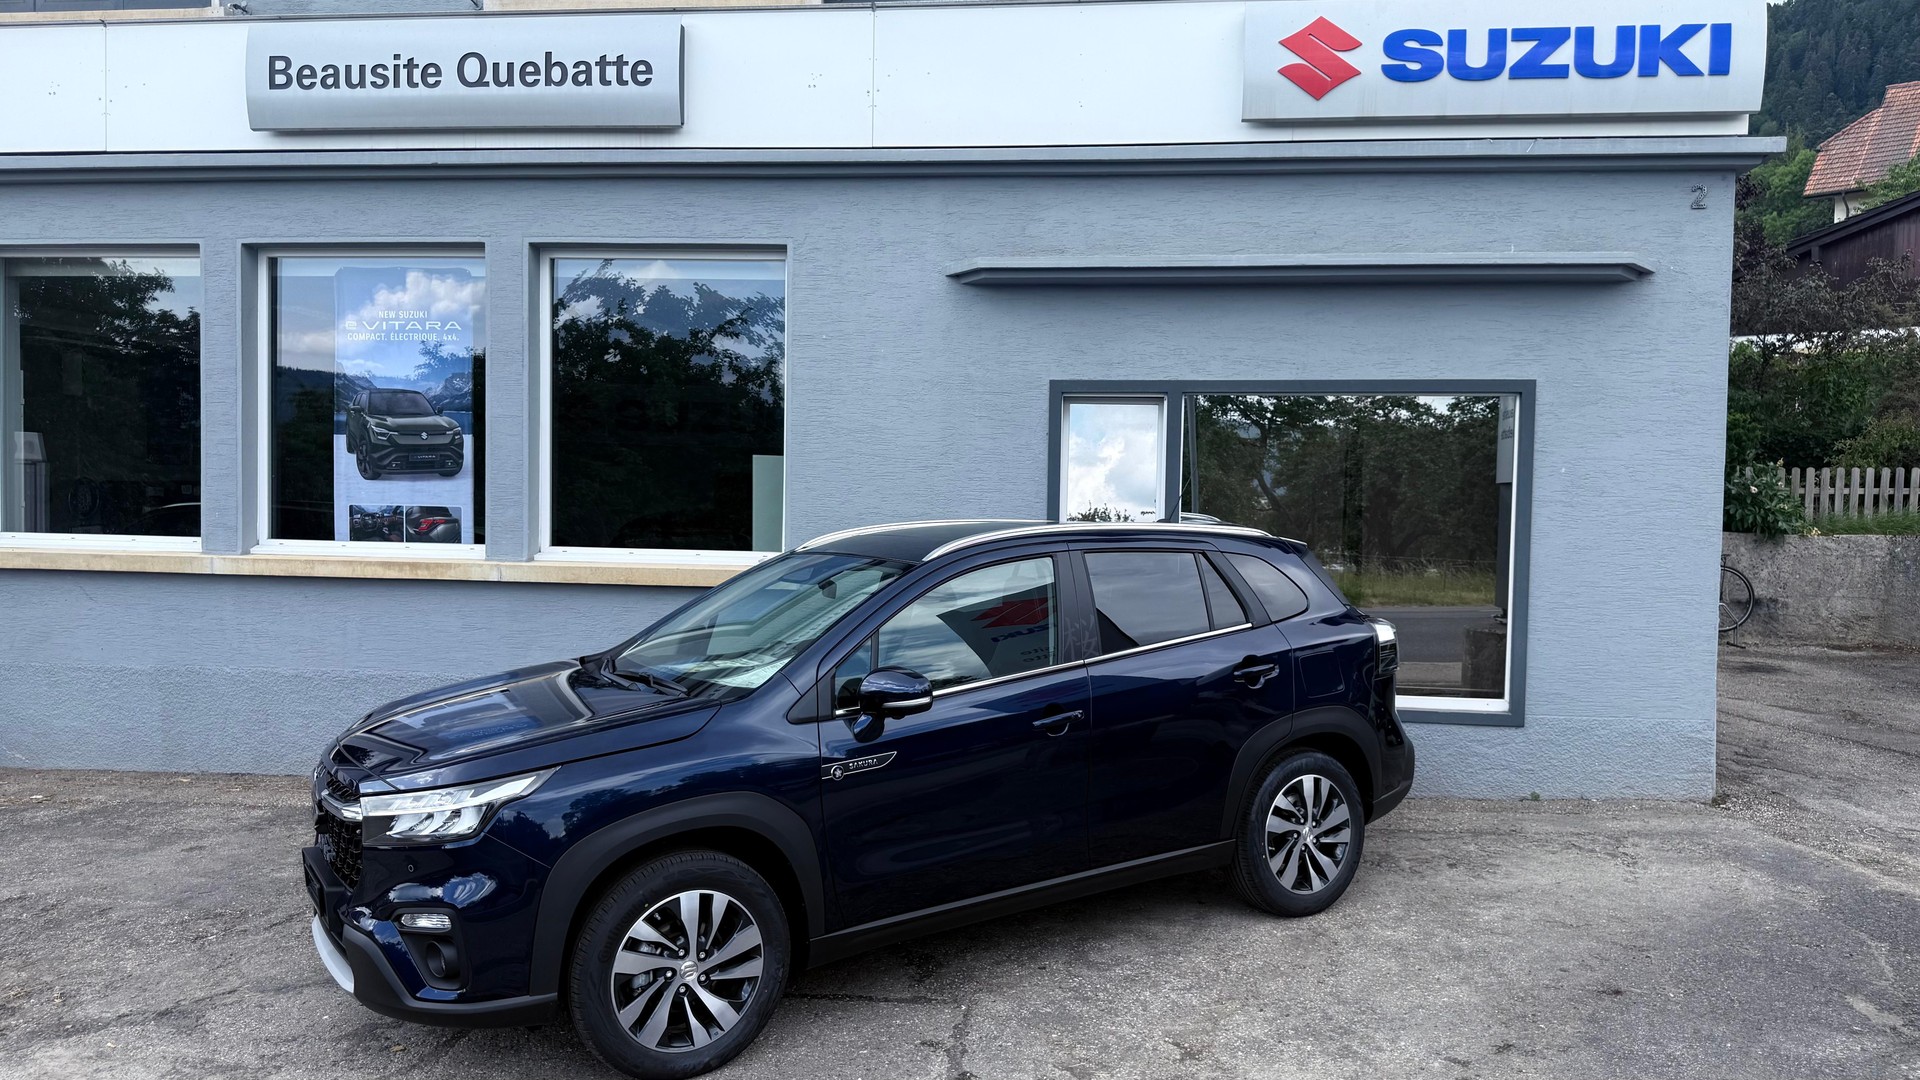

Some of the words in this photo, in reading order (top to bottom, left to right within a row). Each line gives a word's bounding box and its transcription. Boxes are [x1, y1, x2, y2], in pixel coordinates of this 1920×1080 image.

[1380, 22, 1733, 83] SUZUKI
[267, 53, 443, 91] Beausite
[456, 51, 654, 88] Quebatte
[1690, 183, 1708, 210] 2
[378, 310, 396, 319] NEW
[399, 310, 428, 319] SUZUKI
[347, 332, 388, 341] COMPACT.
[390, 331, 440, 341] ÉLECTRIQUE.
[442, 332, 460, 341] 4x4.
[848, 758, 879, 770] SAKURA
